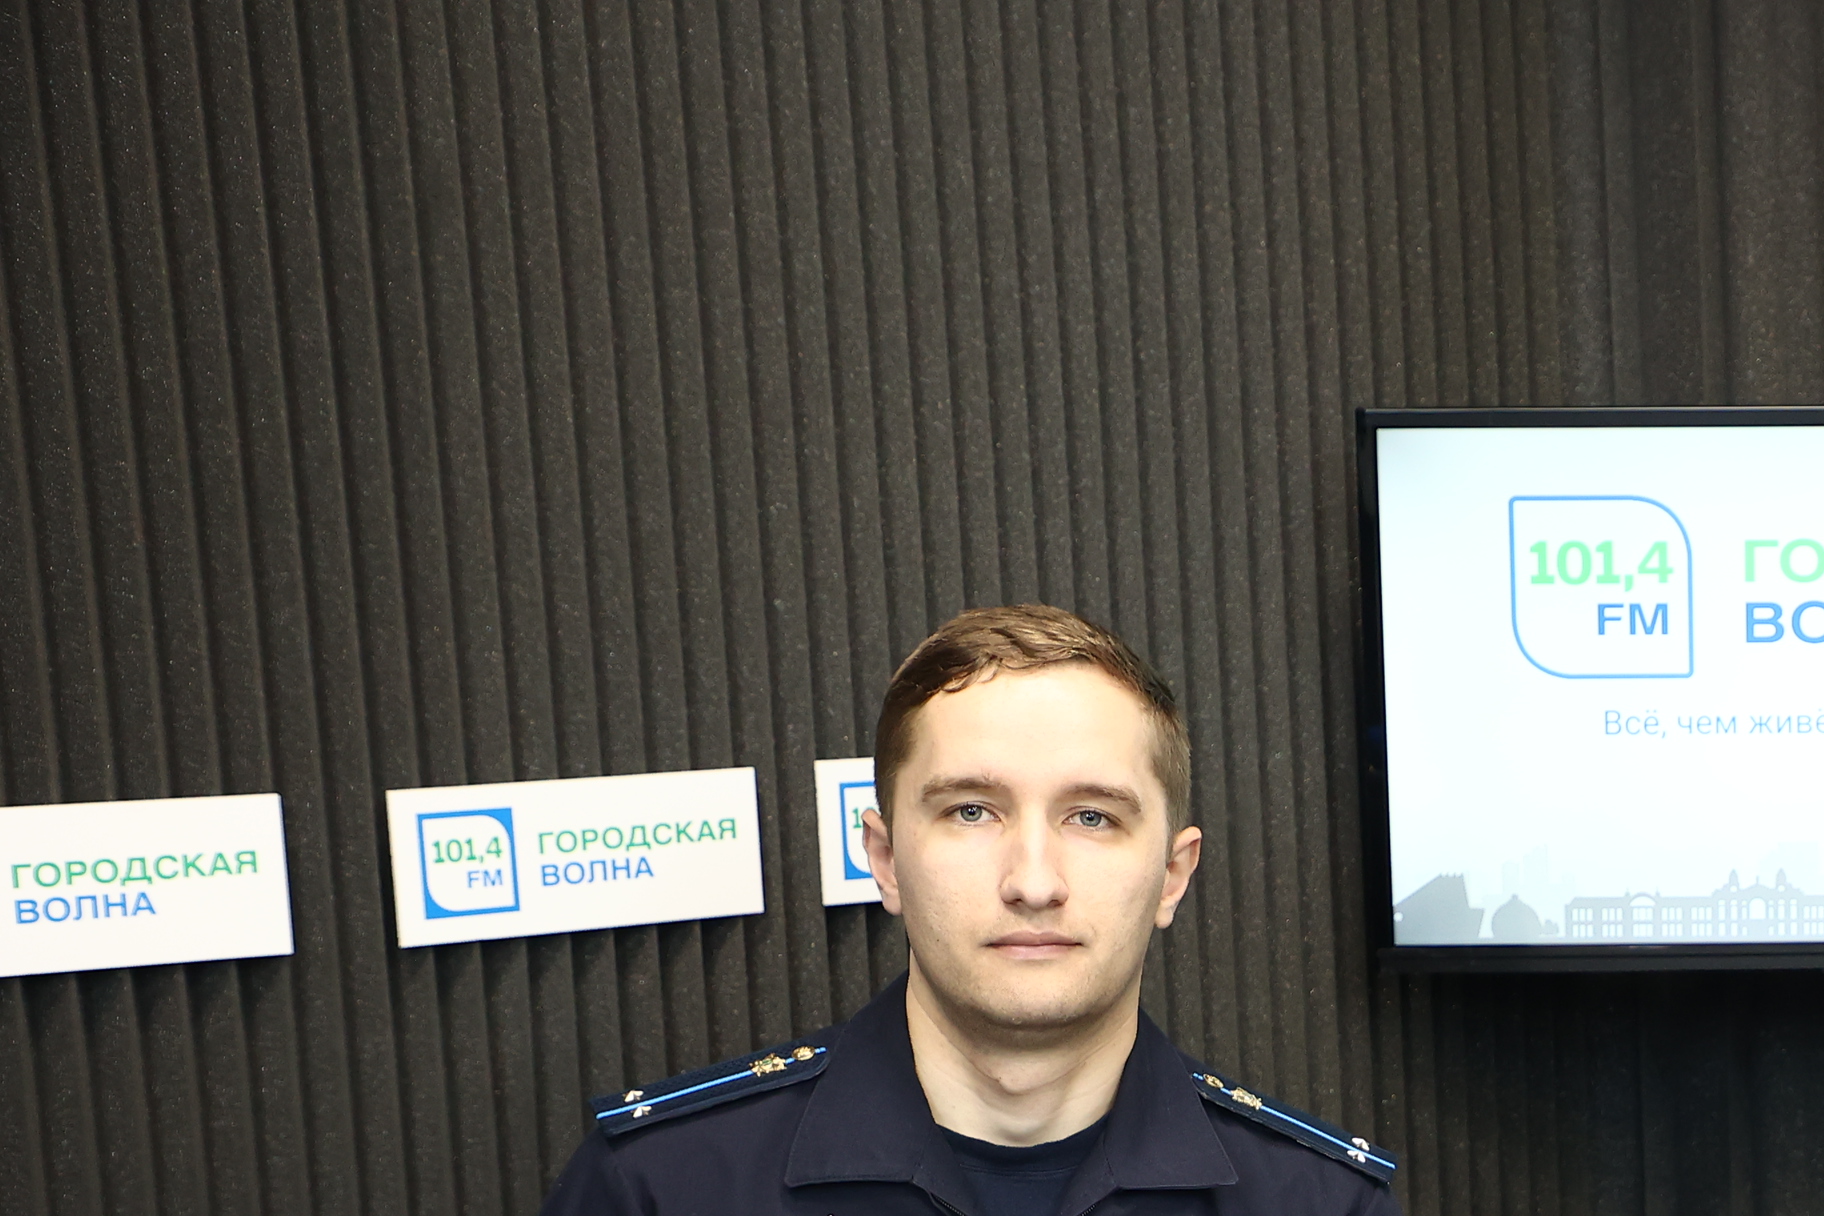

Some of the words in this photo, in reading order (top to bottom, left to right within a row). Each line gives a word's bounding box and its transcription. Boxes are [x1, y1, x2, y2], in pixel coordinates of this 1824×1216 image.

[1528, 540, 1674, 592] 101,4
[1596, 602, 1670, 636] FM
[1603, 709, 1666, 739] Всё,
[1676, 714, 1738, 735] чем
[432, 836, 502, 864] 101,4
[538, 817, 737, 855] ГОРОДСКАЯ
[11, 849, 258, 889] ГОРОДСКАЯ
[467, 868, 503, 889] FM
[541, 855, 654, 887] ВОЛНА
[14, 891, 157, 925] ВОЛНА
